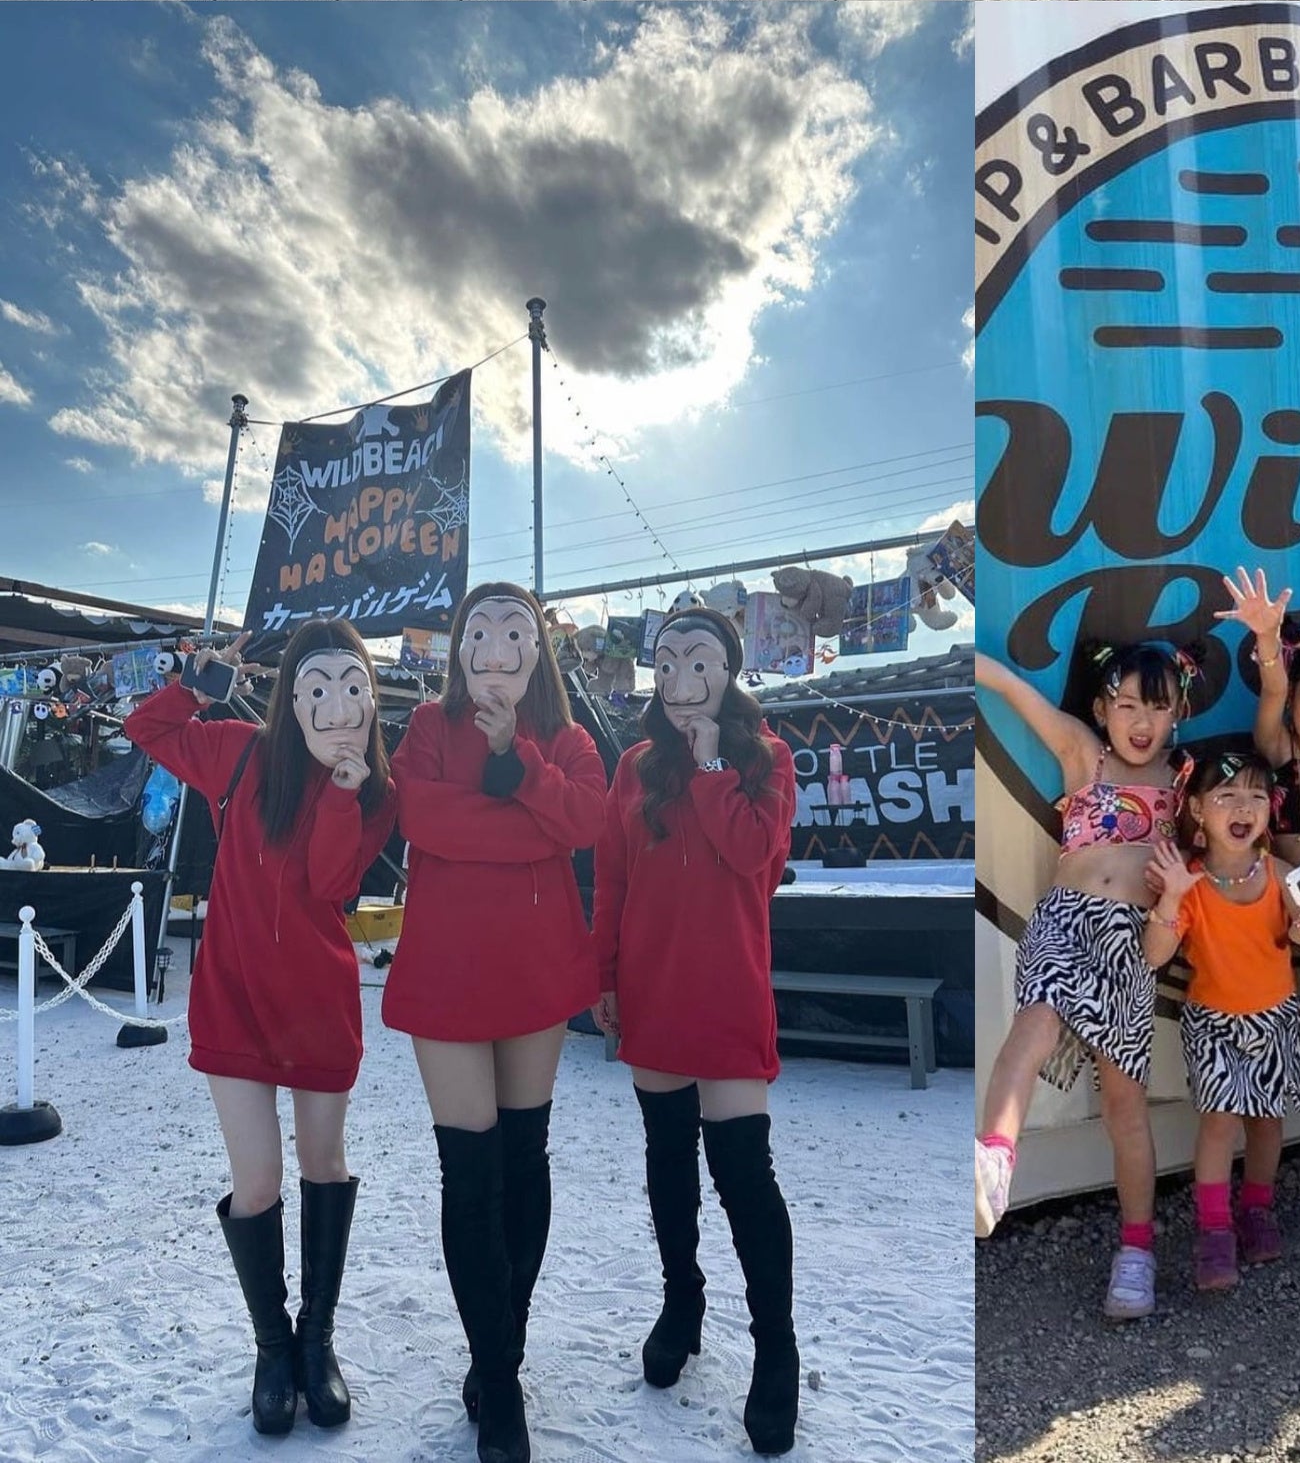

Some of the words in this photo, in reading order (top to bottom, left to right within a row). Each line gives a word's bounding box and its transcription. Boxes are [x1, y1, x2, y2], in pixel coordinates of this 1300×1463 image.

[1027, 113, 1091, 176] &
[324, 482, 422, 544] HAPPY
[279, 518, 460, 593] HALLOWEEN
[792, 742, 938, 777] OTLE
[791, 769, 975, 827] MASH
